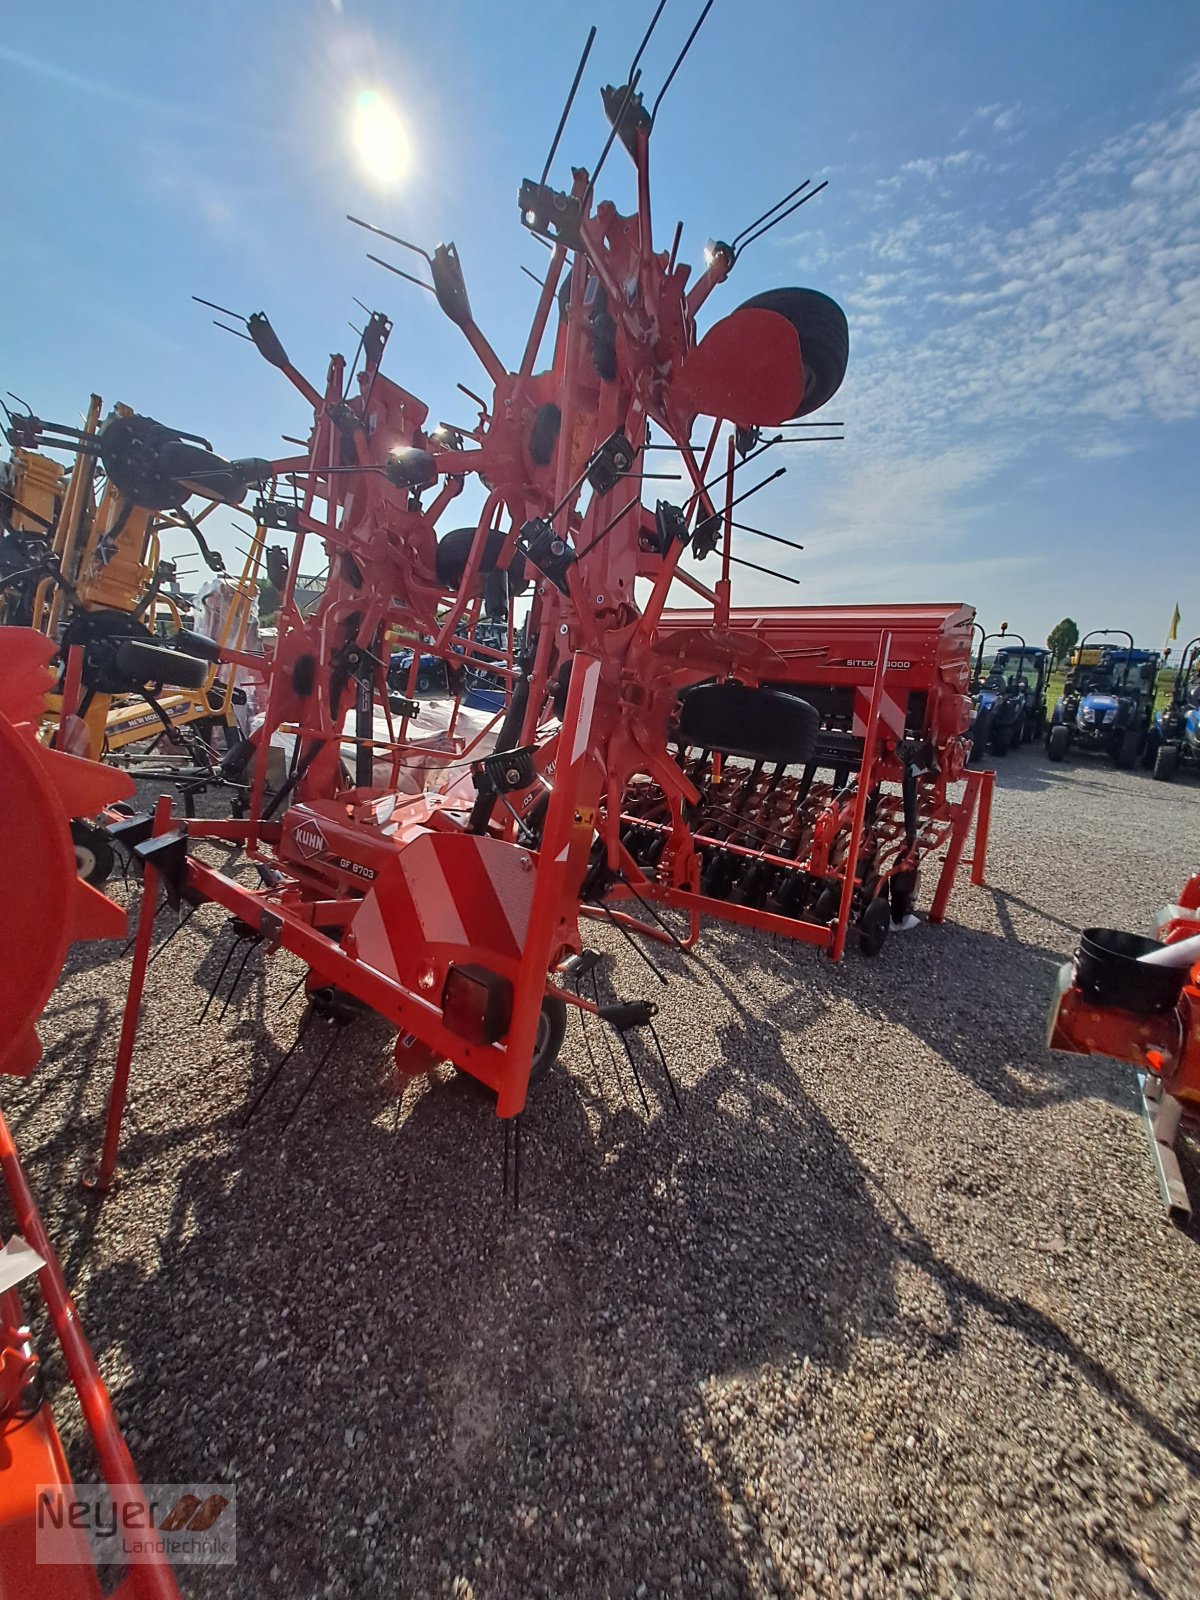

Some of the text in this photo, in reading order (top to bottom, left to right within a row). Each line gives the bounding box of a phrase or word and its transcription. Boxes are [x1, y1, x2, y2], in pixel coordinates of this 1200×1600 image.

[128, 717, 145, 727] NEW
[295, 828, 324, 850] KUHN
[340, 858, 352, 869] GF
